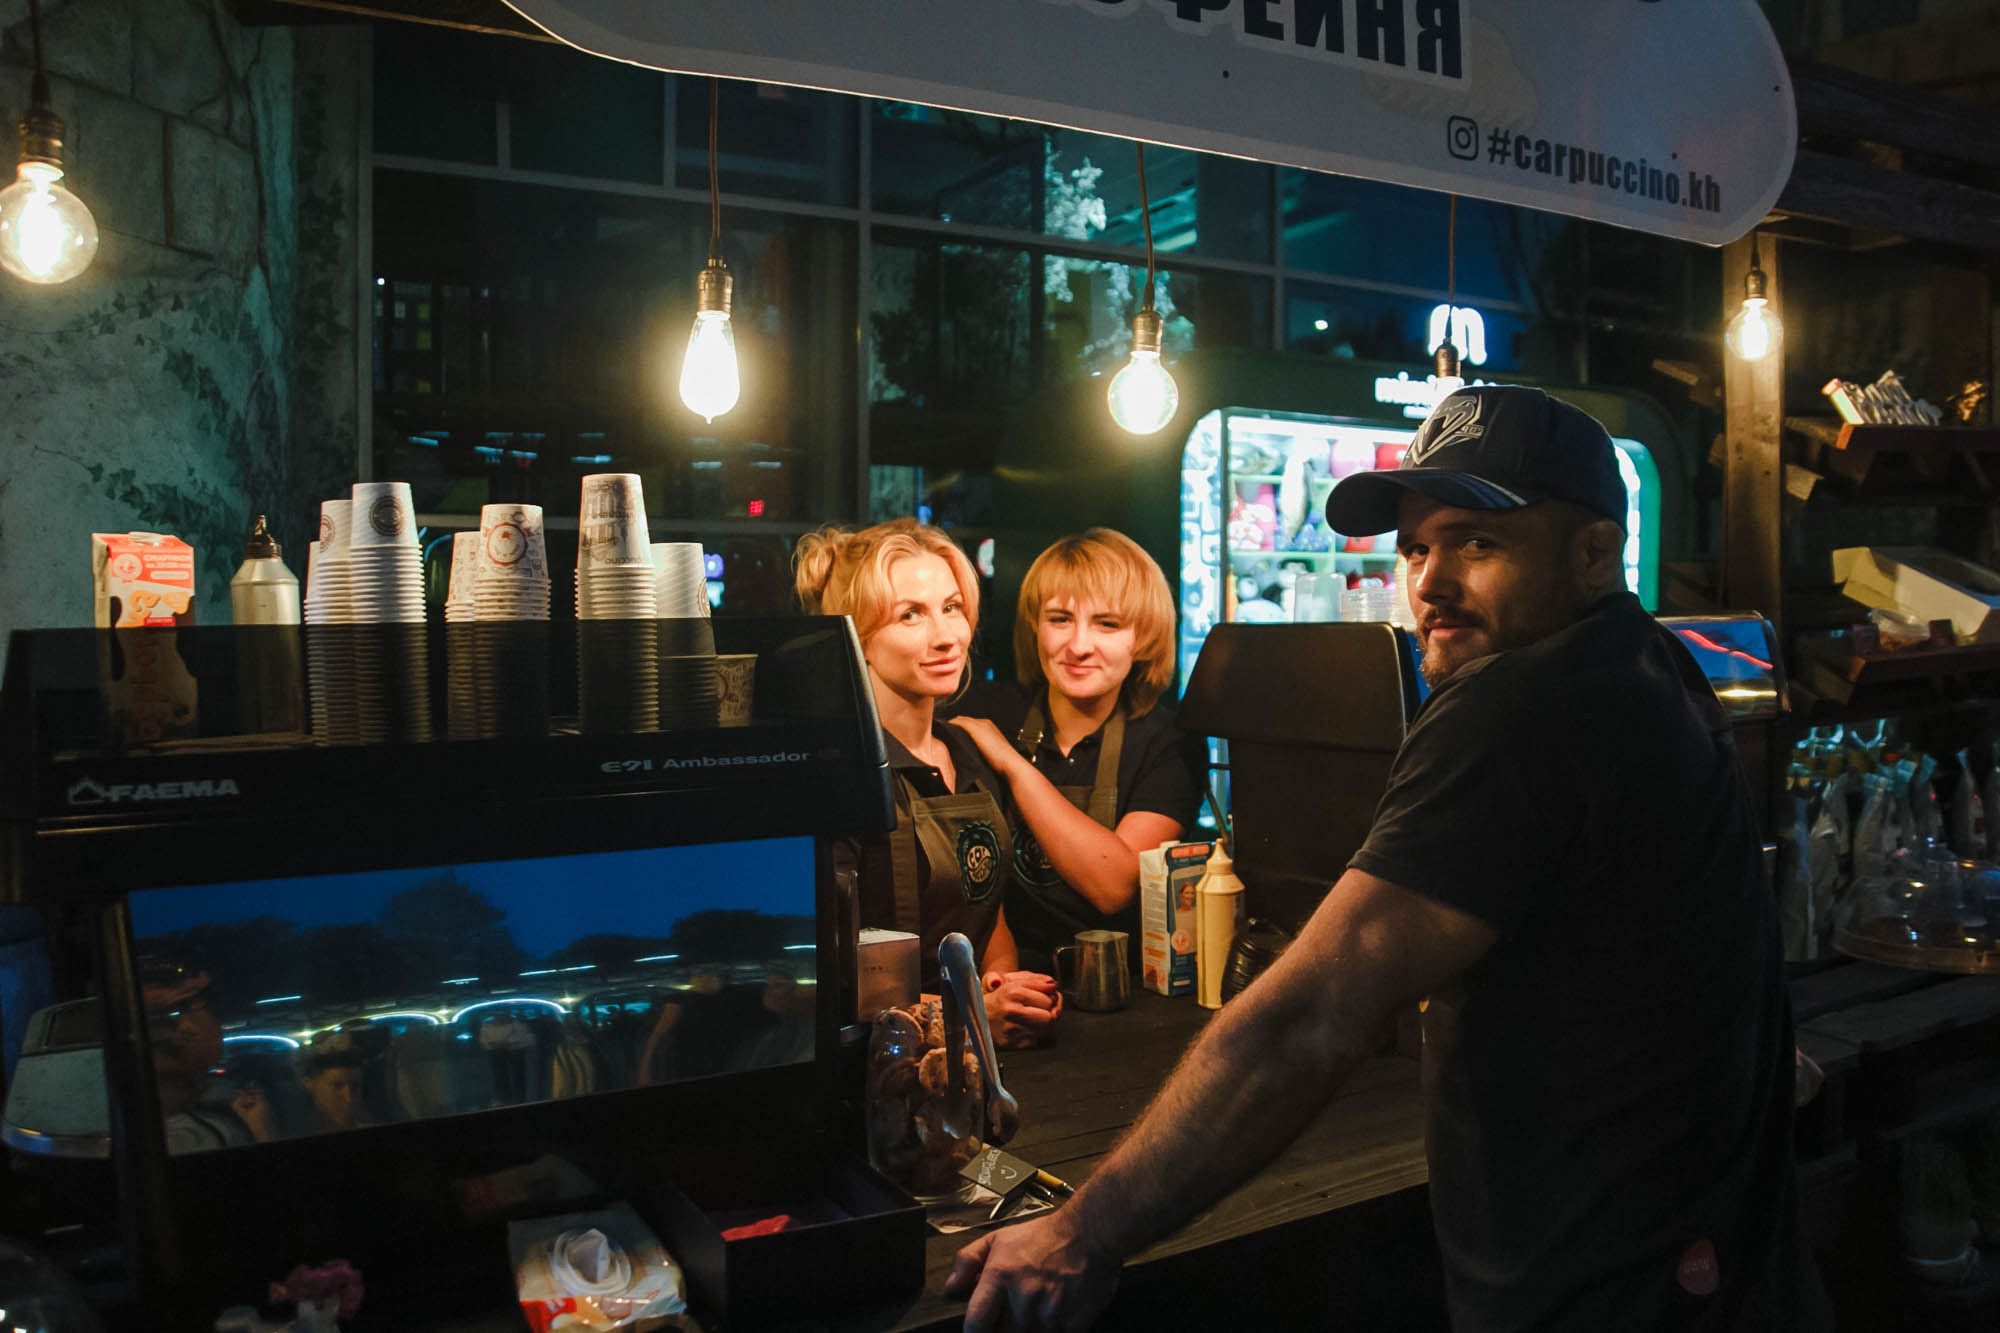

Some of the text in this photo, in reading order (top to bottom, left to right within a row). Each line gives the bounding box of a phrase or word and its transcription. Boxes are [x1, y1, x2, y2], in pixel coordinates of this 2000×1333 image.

[1488, 127, 1721, 212] #carpuccino.kh
[663, 751, 811, 769] Ambassador
[108, 778, 240, 802] FAEMA
